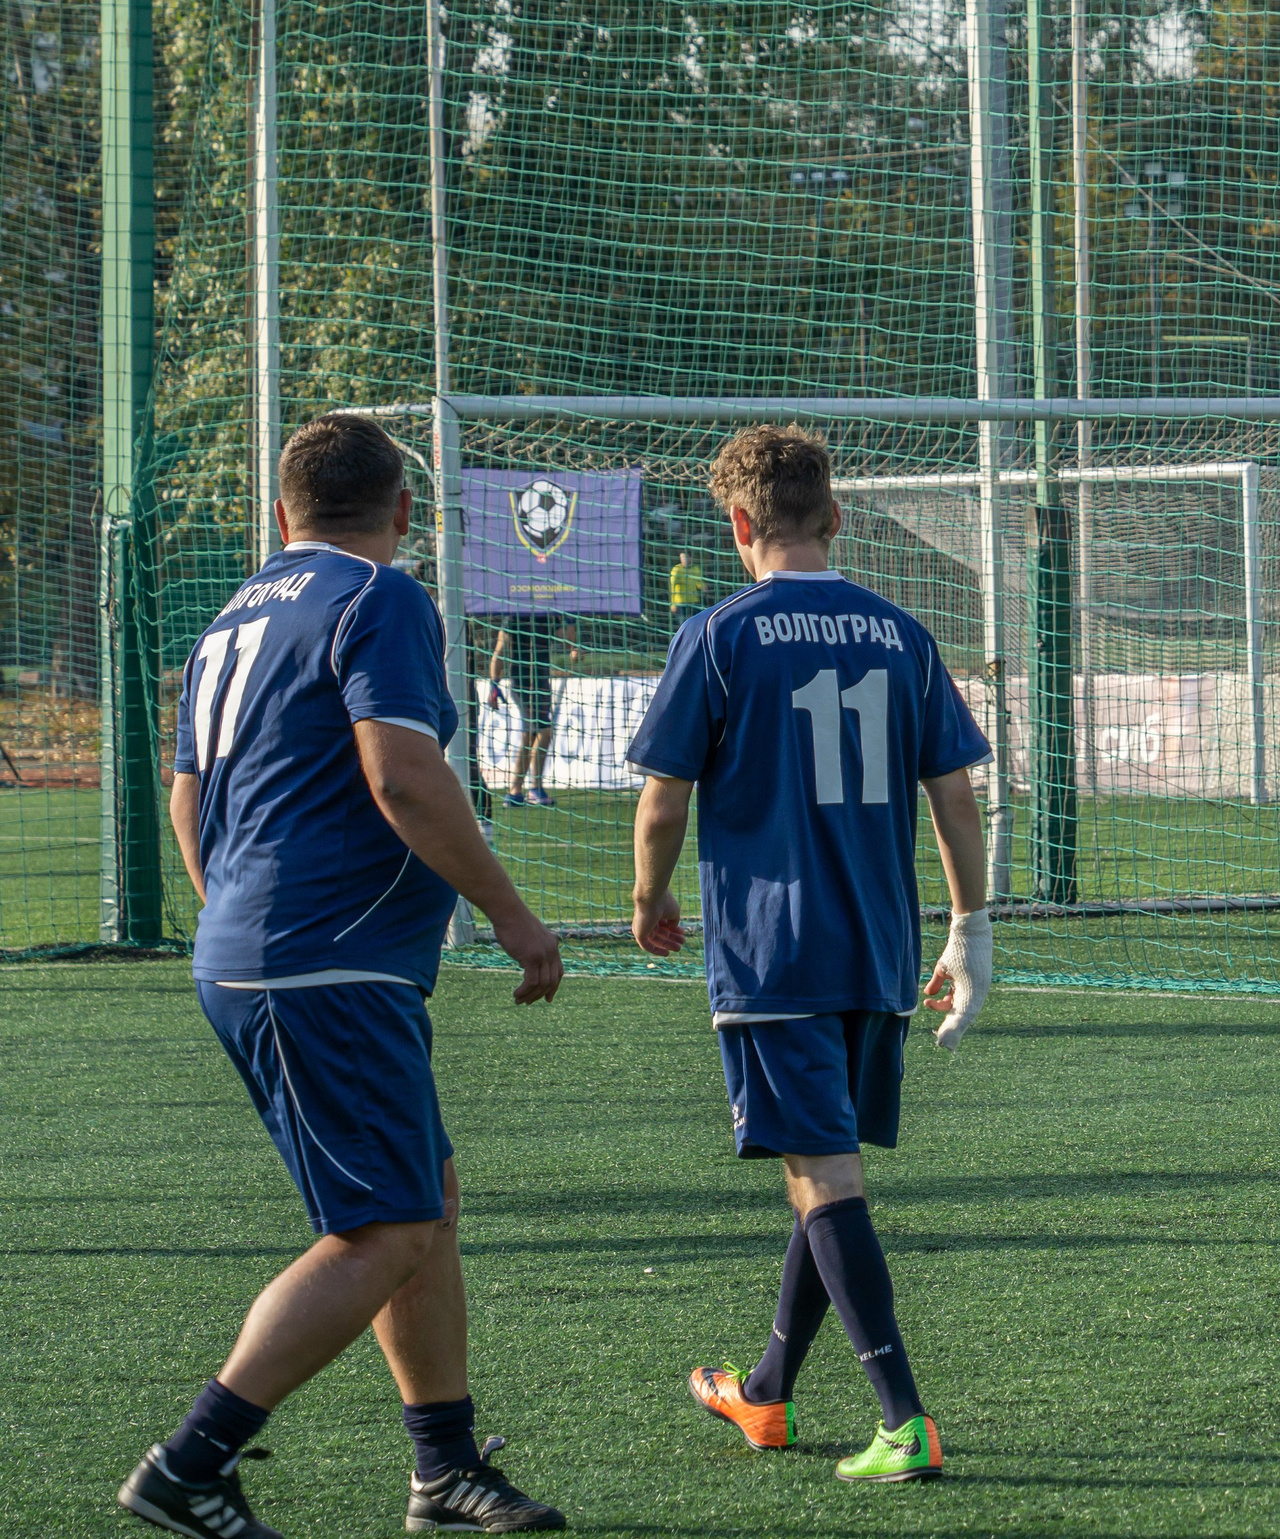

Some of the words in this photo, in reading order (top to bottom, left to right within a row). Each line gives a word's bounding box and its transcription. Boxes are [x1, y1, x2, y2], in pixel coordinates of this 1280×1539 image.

[213, 572, 316, 622] ОЛГОГРАД
[754, 613, 903, 651] ВОЛГОГРАД
[193, 616, 270, 773] 11
[792, 669, 889, 804] 11
